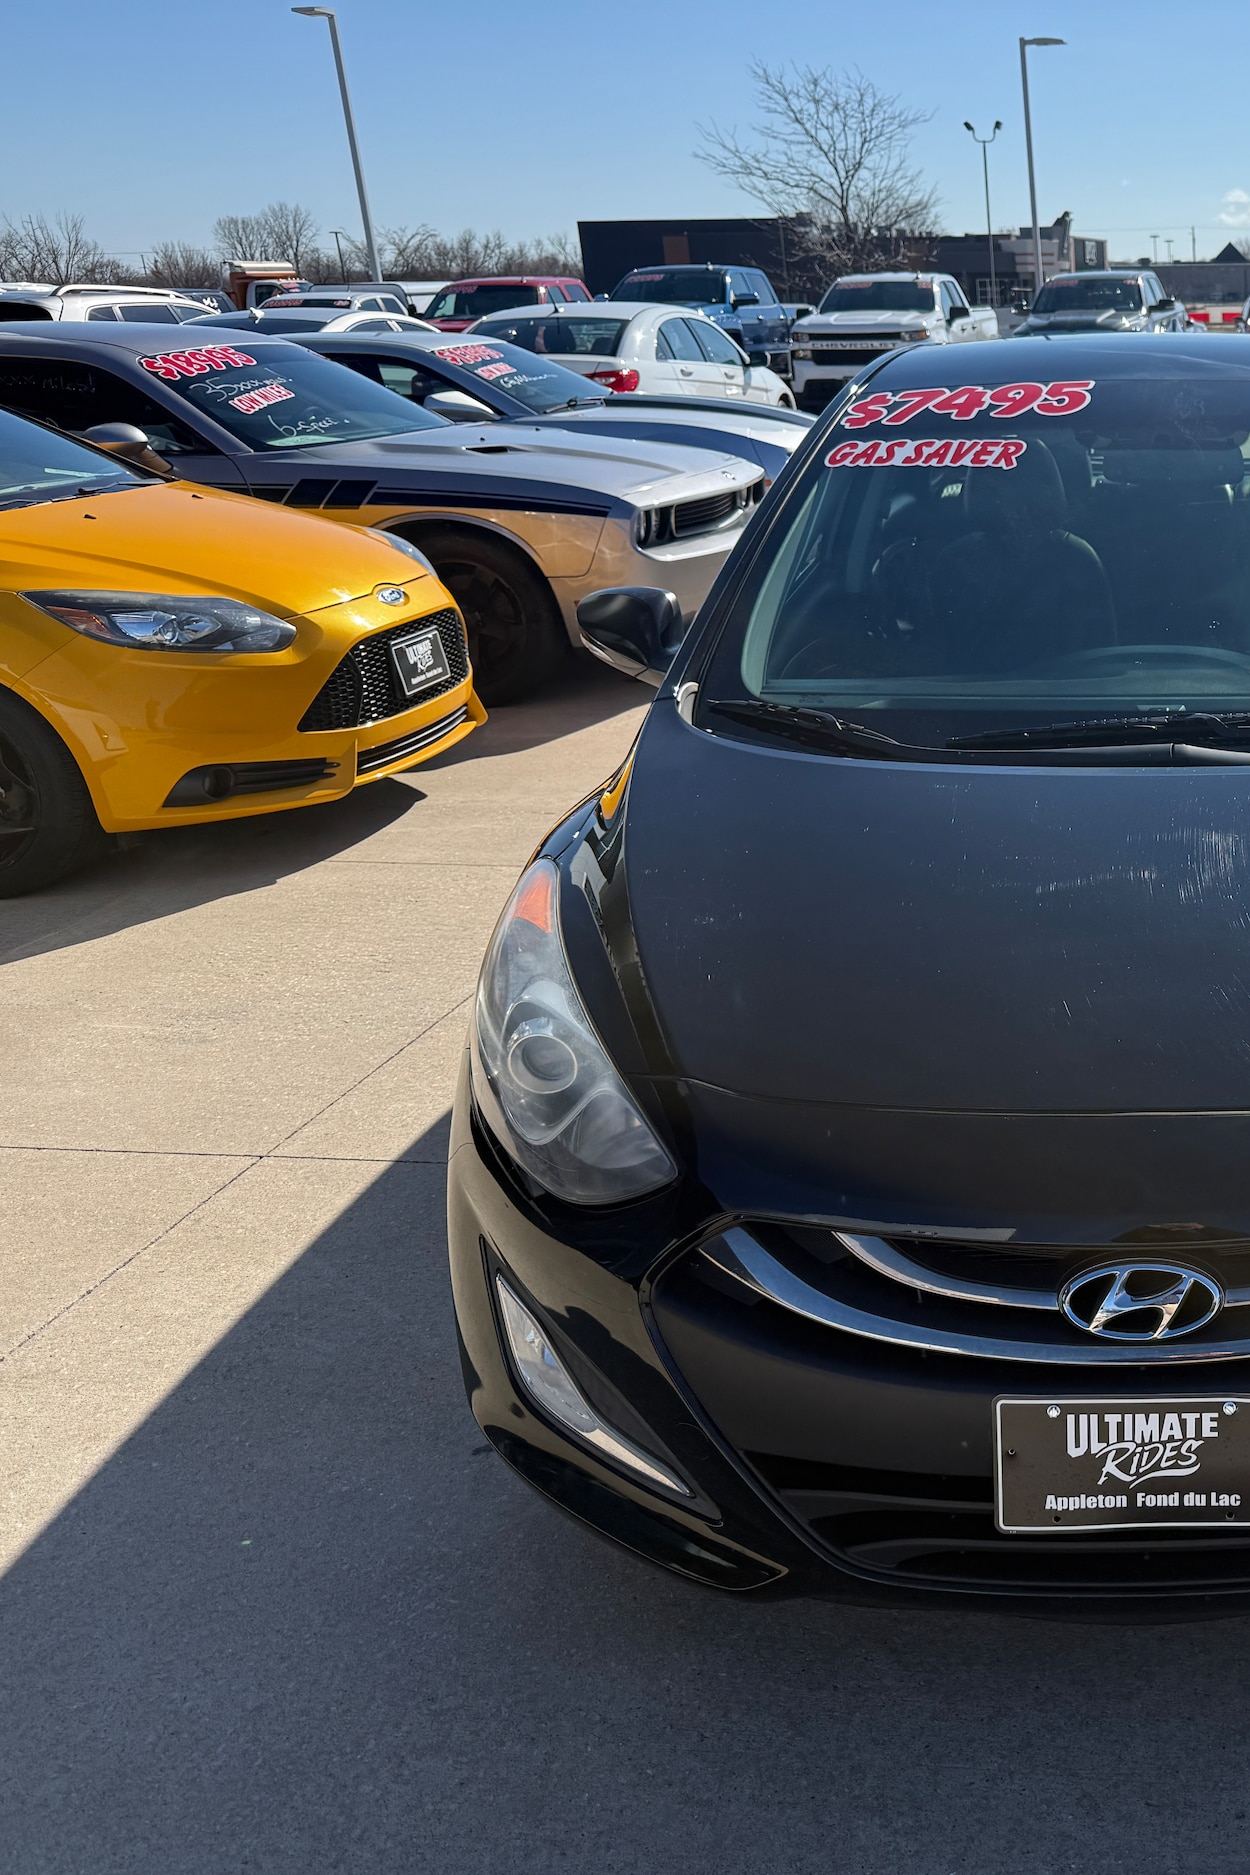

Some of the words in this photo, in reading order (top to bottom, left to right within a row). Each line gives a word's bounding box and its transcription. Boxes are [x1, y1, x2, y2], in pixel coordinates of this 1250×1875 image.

[141, 346, 257, 380] $18995
[228, 390, 264, 414] LOW
[257, 384, 296, 407] MILES
[841, 380, 1096, 429] $7495
[824, 439, 909, 468] GAS
[901, 439, 1027, 470] SAVER
[1066, 1412, 1219, 1458] ULTIMATE
[1045, 1494, 1127, 1510] Appleton
[1136, 1492, 1180, 1507] Fond
[1183, 1491, 1208, 1506] du
[1210, 1492, 1241, 1506] Lac
